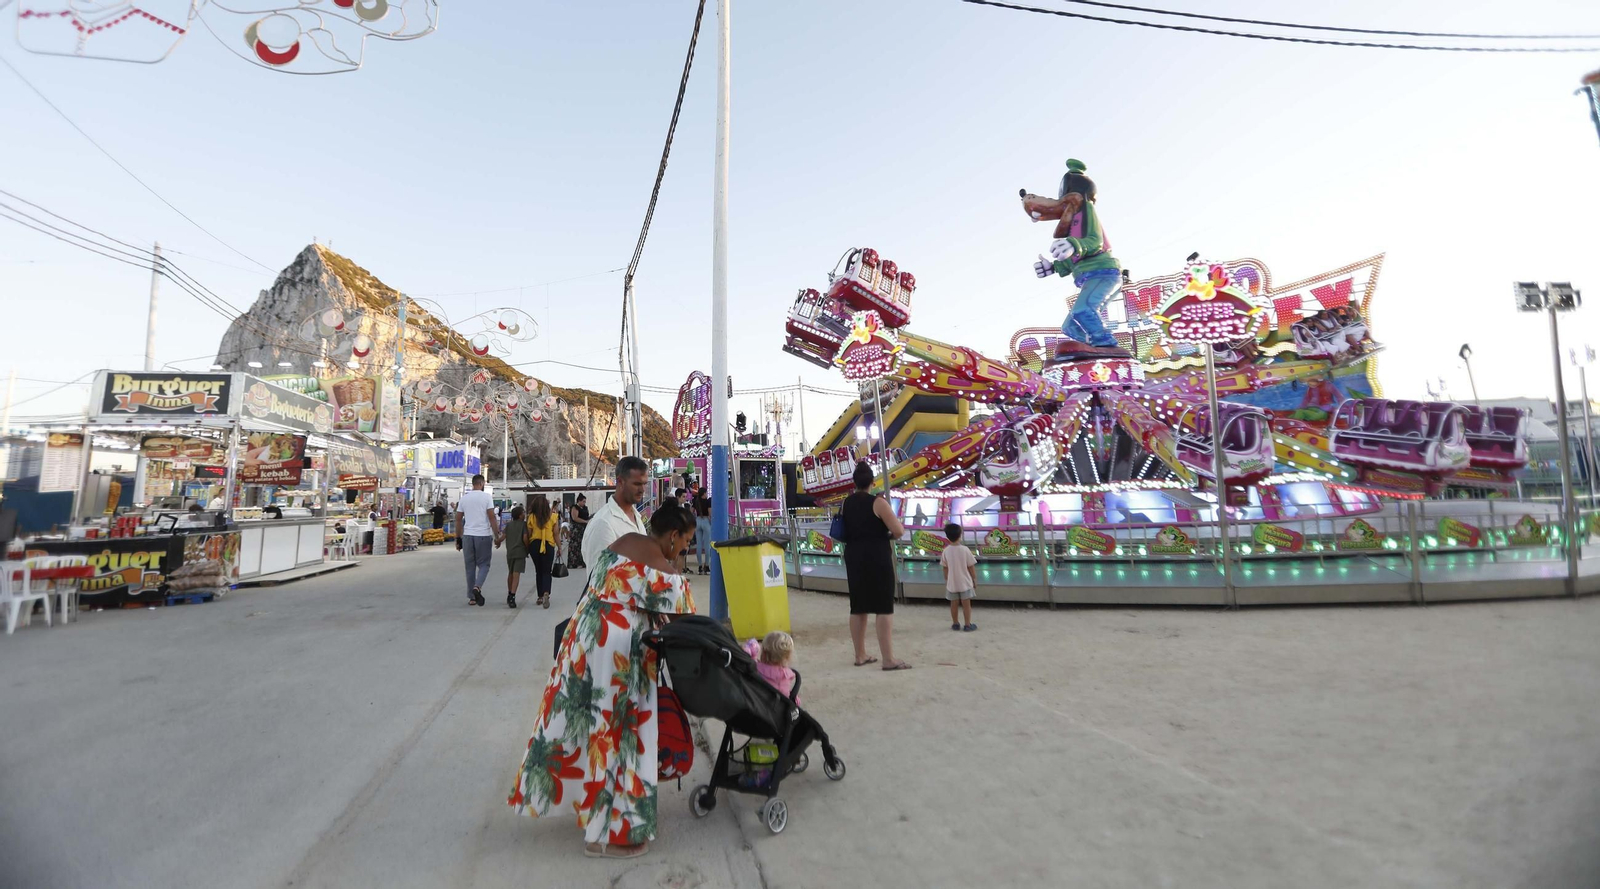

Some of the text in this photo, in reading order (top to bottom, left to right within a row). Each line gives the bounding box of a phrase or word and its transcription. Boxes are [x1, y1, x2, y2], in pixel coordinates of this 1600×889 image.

[1169, 317, 1249, 338] GOOFY
[111, 374, 225, 396] Burguer
[146, 394, 192, 408] Inma
[676, 410, 709, 440] GOOF
[260, 469, 290, 478] kebab
